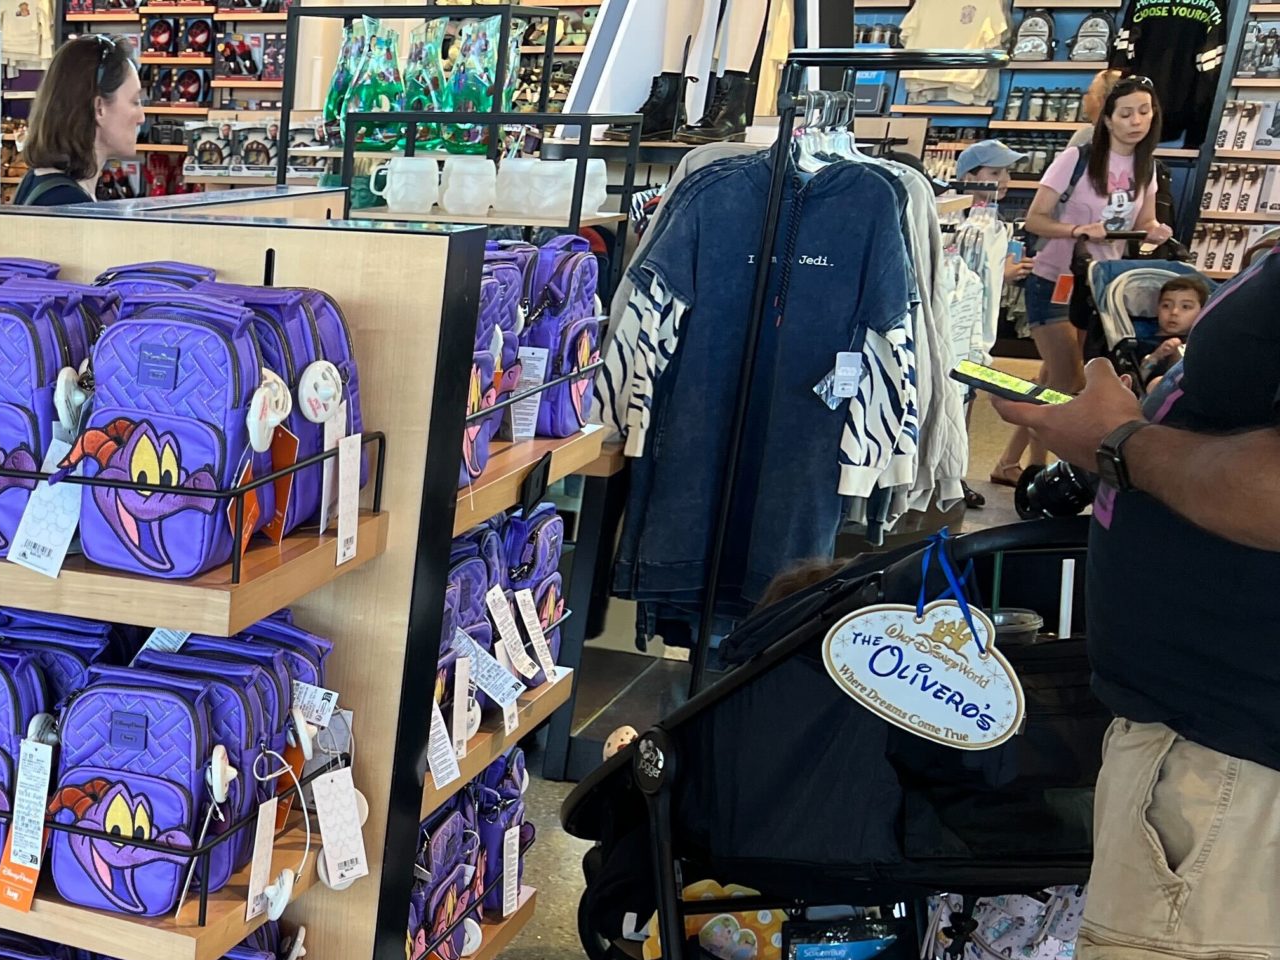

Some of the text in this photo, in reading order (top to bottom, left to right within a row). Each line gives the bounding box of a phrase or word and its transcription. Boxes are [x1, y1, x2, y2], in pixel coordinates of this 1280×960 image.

[748, 255, 755, 264] I
[799, 255, 835, 267] Jedi.
[852, 631, 883, 646] THE
[959, 663, 990, 689] World
[839, 664, 969, 742] Where Dreams Come True
